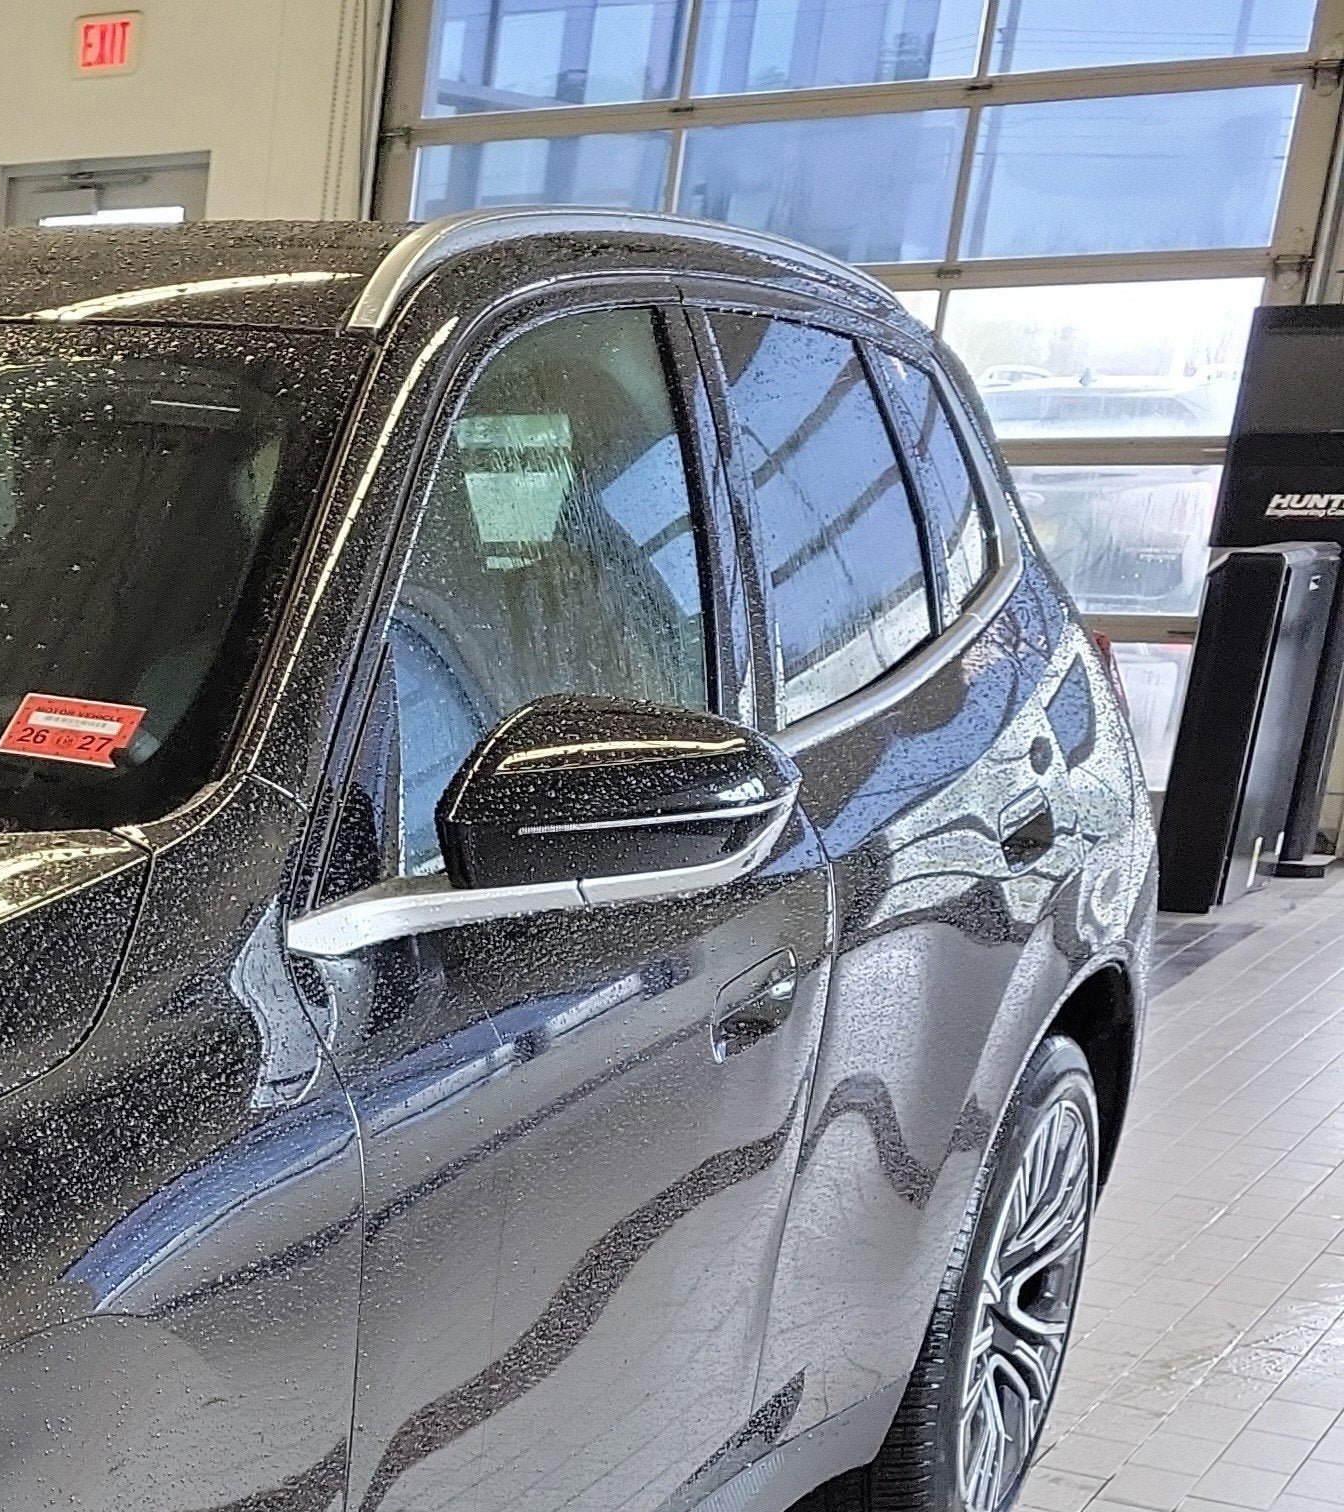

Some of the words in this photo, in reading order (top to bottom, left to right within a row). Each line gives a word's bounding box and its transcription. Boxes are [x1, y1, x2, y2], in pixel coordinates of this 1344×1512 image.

[81, 21, 130, 67] EXIT
[1268, 494, 1344, 508] HUNT
[35, 706, 75, 716] MOTOR
[78, 711, 125, 722] VEHICLE
[16, 726, 50, 745] 26
[76, 735, 114, 752] 27
